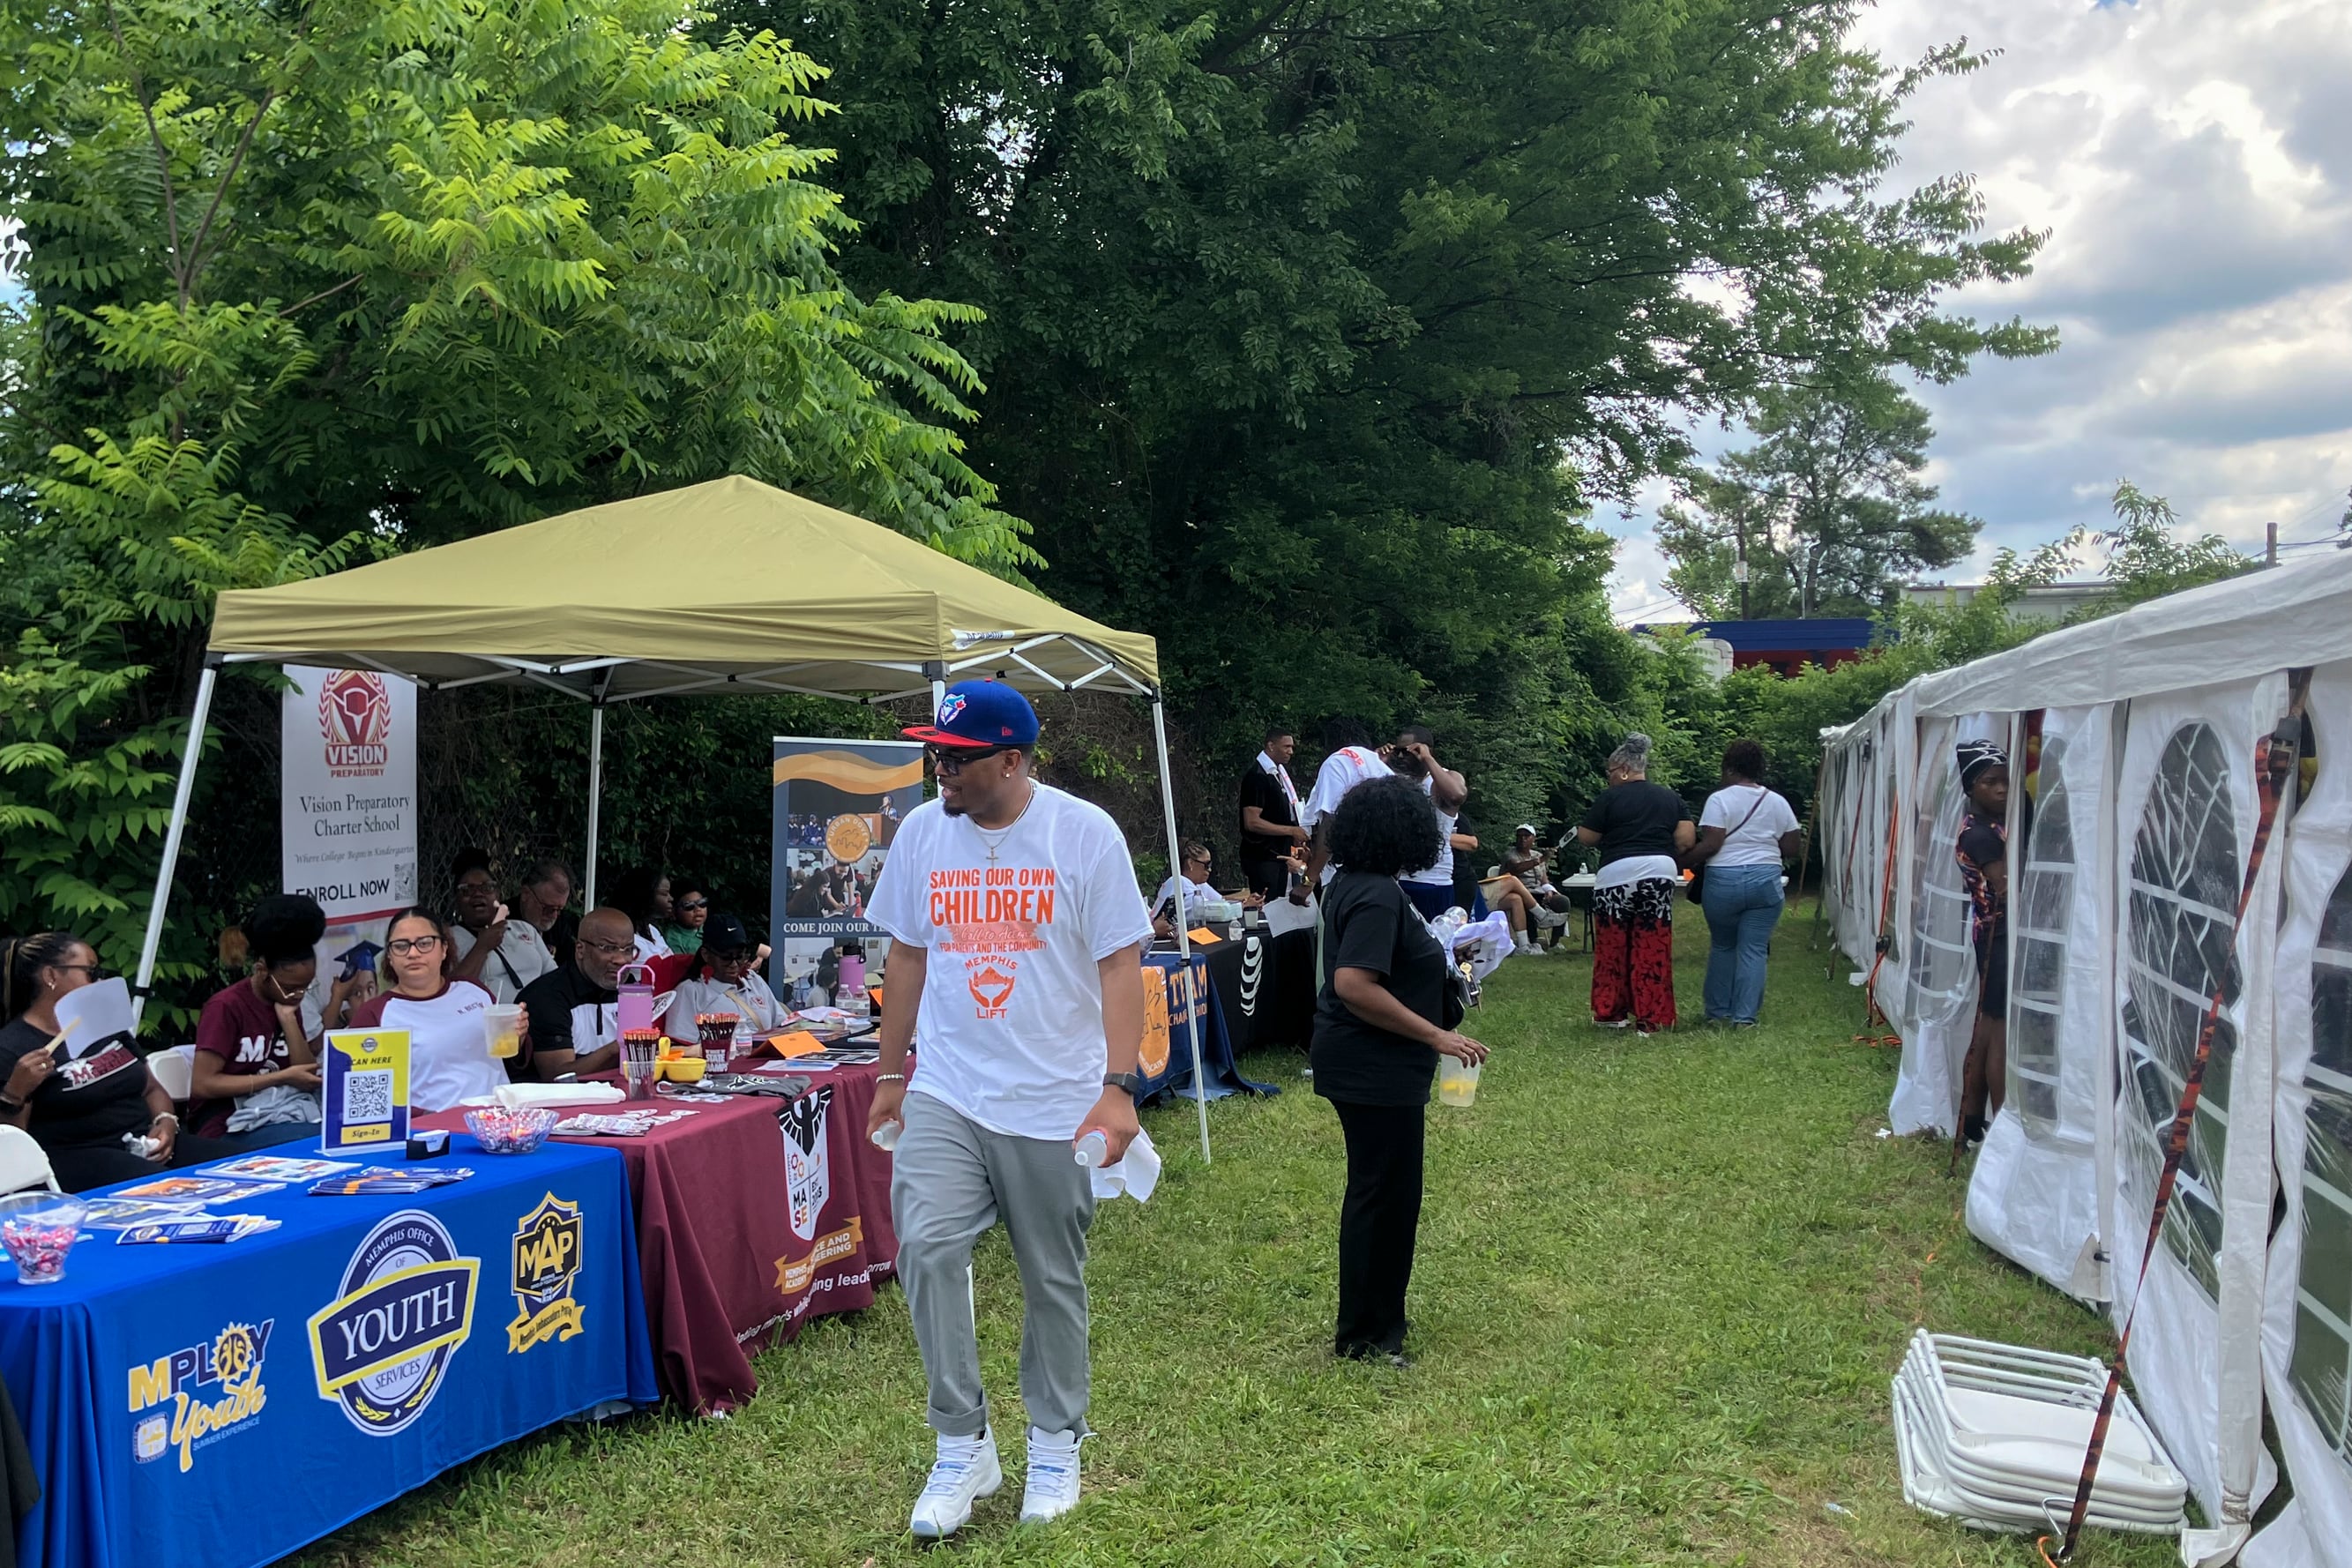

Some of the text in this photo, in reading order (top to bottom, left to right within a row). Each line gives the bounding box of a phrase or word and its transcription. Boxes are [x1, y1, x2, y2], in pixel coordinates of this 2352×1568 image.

[327, 745, 385, 765] VISION
[331, 768, 385, 779] PREPARATORY
[300, 794, 410, 813] Vision Preparatory
[314, 813, 399, 837] Charter School
[830, 818, 850, 837] URBAN
[360, 878, 390, 897] NOW
[930, 868, 1055, 889] SAVING OUR OWN
[930, 889, 1055, 926] CHILDREN
[783, 922, 816, 933] COME
[818, 922, 843, 935] JOIN
[847, 922, 869, 932] OUR
[961, 927, 982, 942] Call
[984, 930, 995, 940] to
[939, 943, 952, 952] FOR
[976, 943, 992, 953] AND
[994, 942, 1007, 952] THE
[1009, 940, 1047, 952] COMMUNITY
[965, 955, 1018, 971] MEMPHIS
[975, 1007, 1008, 1019] LIFT
[370, 1056, 392, 1065] HERE
[352, 1130, 380, 1139] Sign-In
[794, 1188, 807, 1210] MA
[795, 1205, 808, 1228] SE
[365, 1227, 435, 1267] MEMPHIS OFFICE
[828, 1232, 850, 1246] AND
[395, 1258, 406, 1268] OF
[519, 1227, 574, 1282] MAP
[338, 1281, 456, 1361] YOUTH
[375, 1358, 421, 1390] SERVICES
[170, 1363, 266, 1473] Youth
[192, 1430, 221, 1451] SUMMER
[221, 1416, 260, 1440] EXPERIENCE
